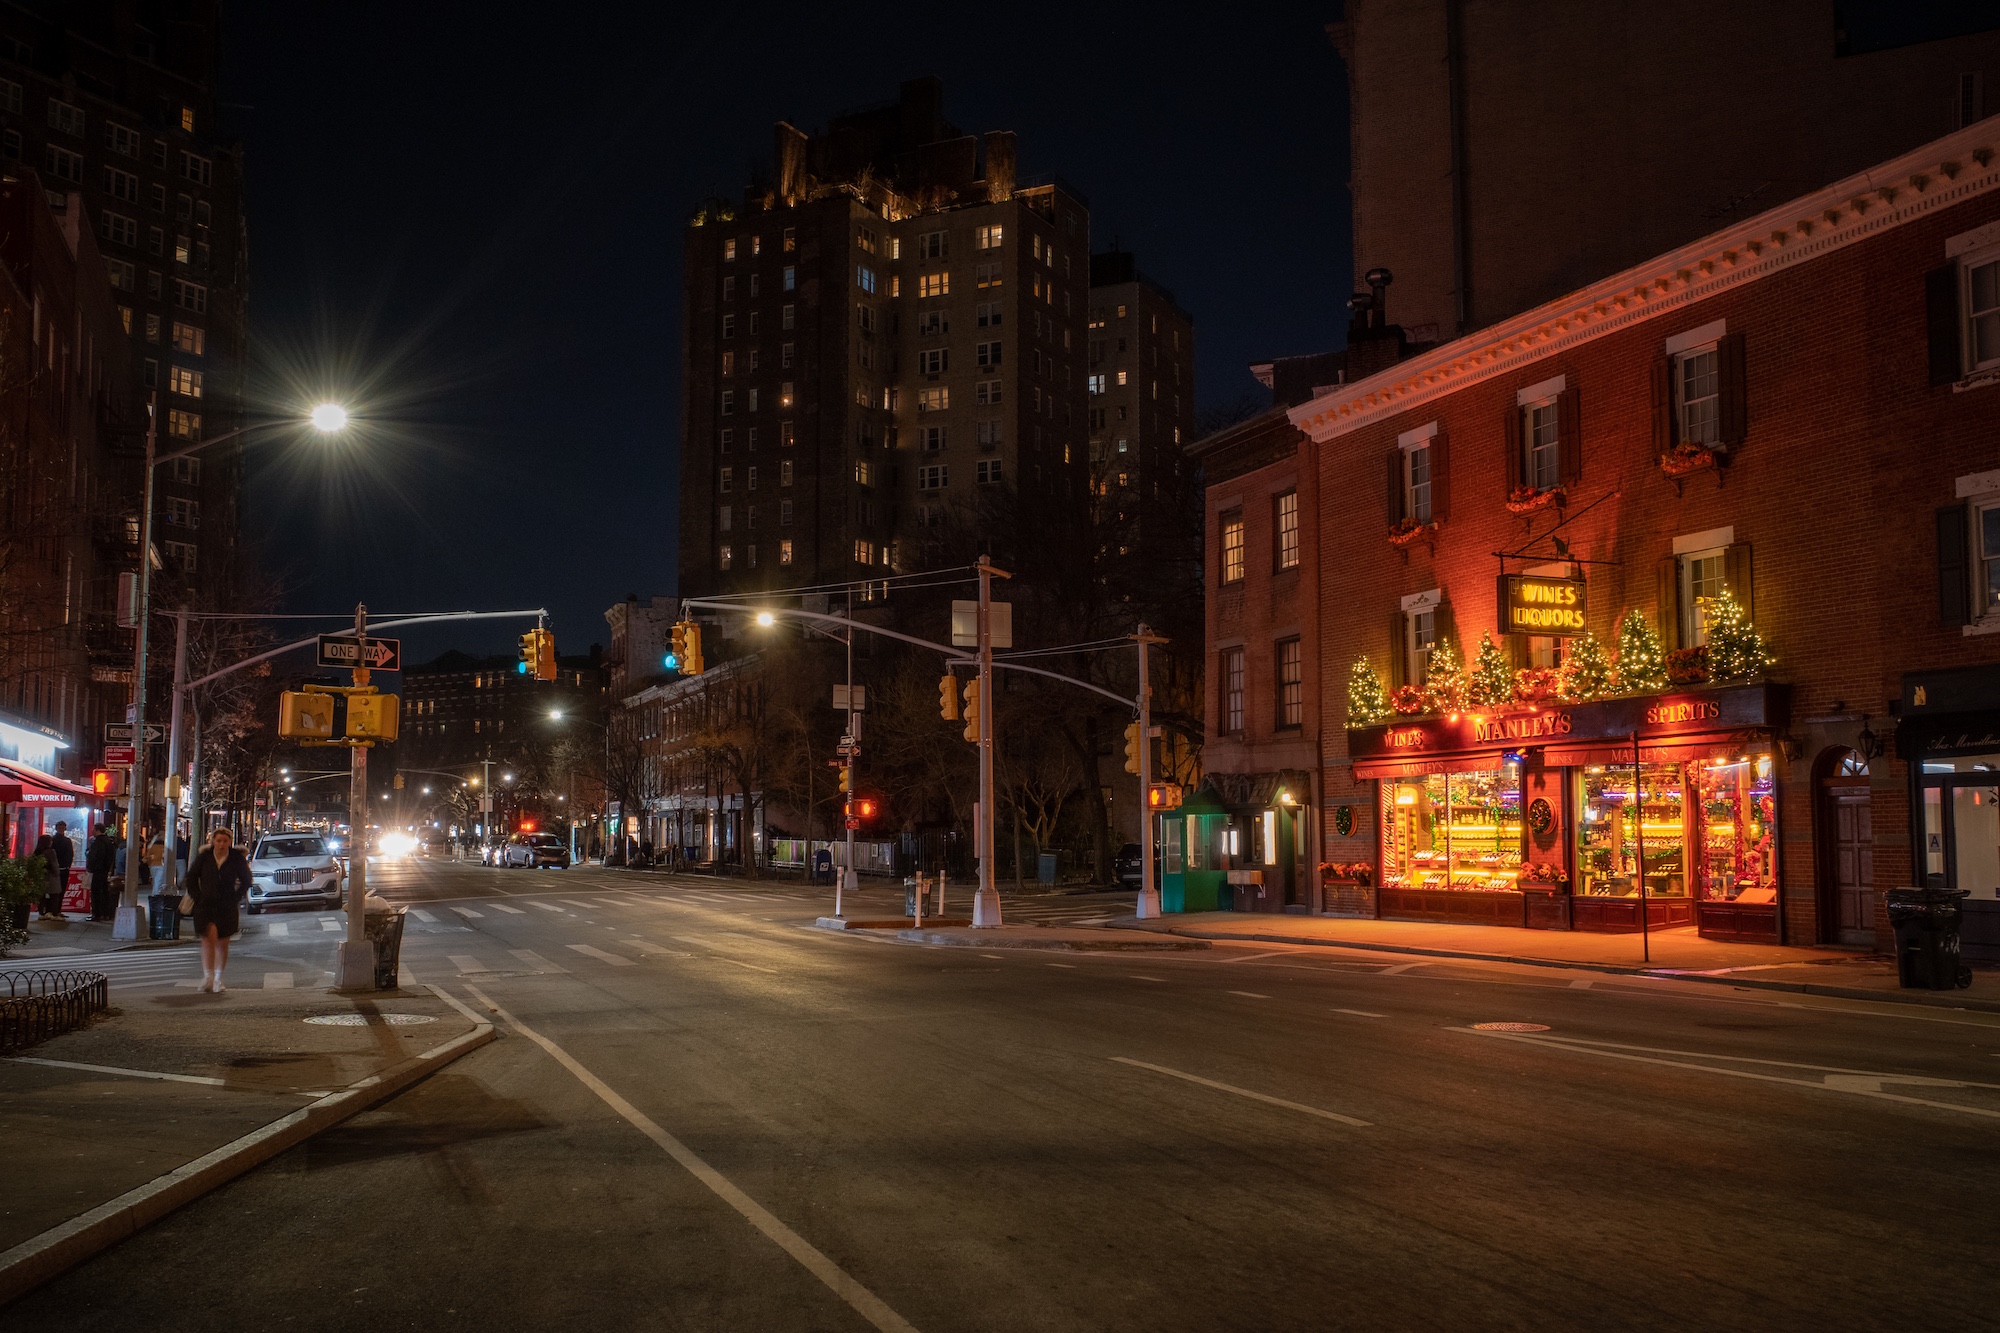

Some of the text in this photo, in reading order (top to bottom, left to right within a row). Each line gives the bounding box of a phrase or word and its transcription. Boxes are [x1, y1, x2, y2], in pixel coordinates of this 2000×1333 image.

[1521, 584, 1576, 605] WINES
[1513, 606, 1585, 628] LIQUORS
[330, 645, 387, 660] ONE WAY
[96, 670, 132, 683] JANE ST
[1647, 701, 1720, 724] SPIRITS
[112, 729, 128, 737] ONE
[1475, 712, 1572, 742] MANLEY'S
[1384, 731, 1423, 747] WINES
[1550, 755, 1573, 764] WINES
[1709, 746, 1740, 757] SPIRITS
[1356, 769, 1374, 777] WINES
[1402, 761, 1444, 776] MANLEY'S
[1472, 760, 1496, 770] SPIRITS
[22, 794, 40, 802] NEW
[40, 794, 60, 802] YORK
[1930, 835, 1940, 848] A
[68, 883, 82, 891] WE
